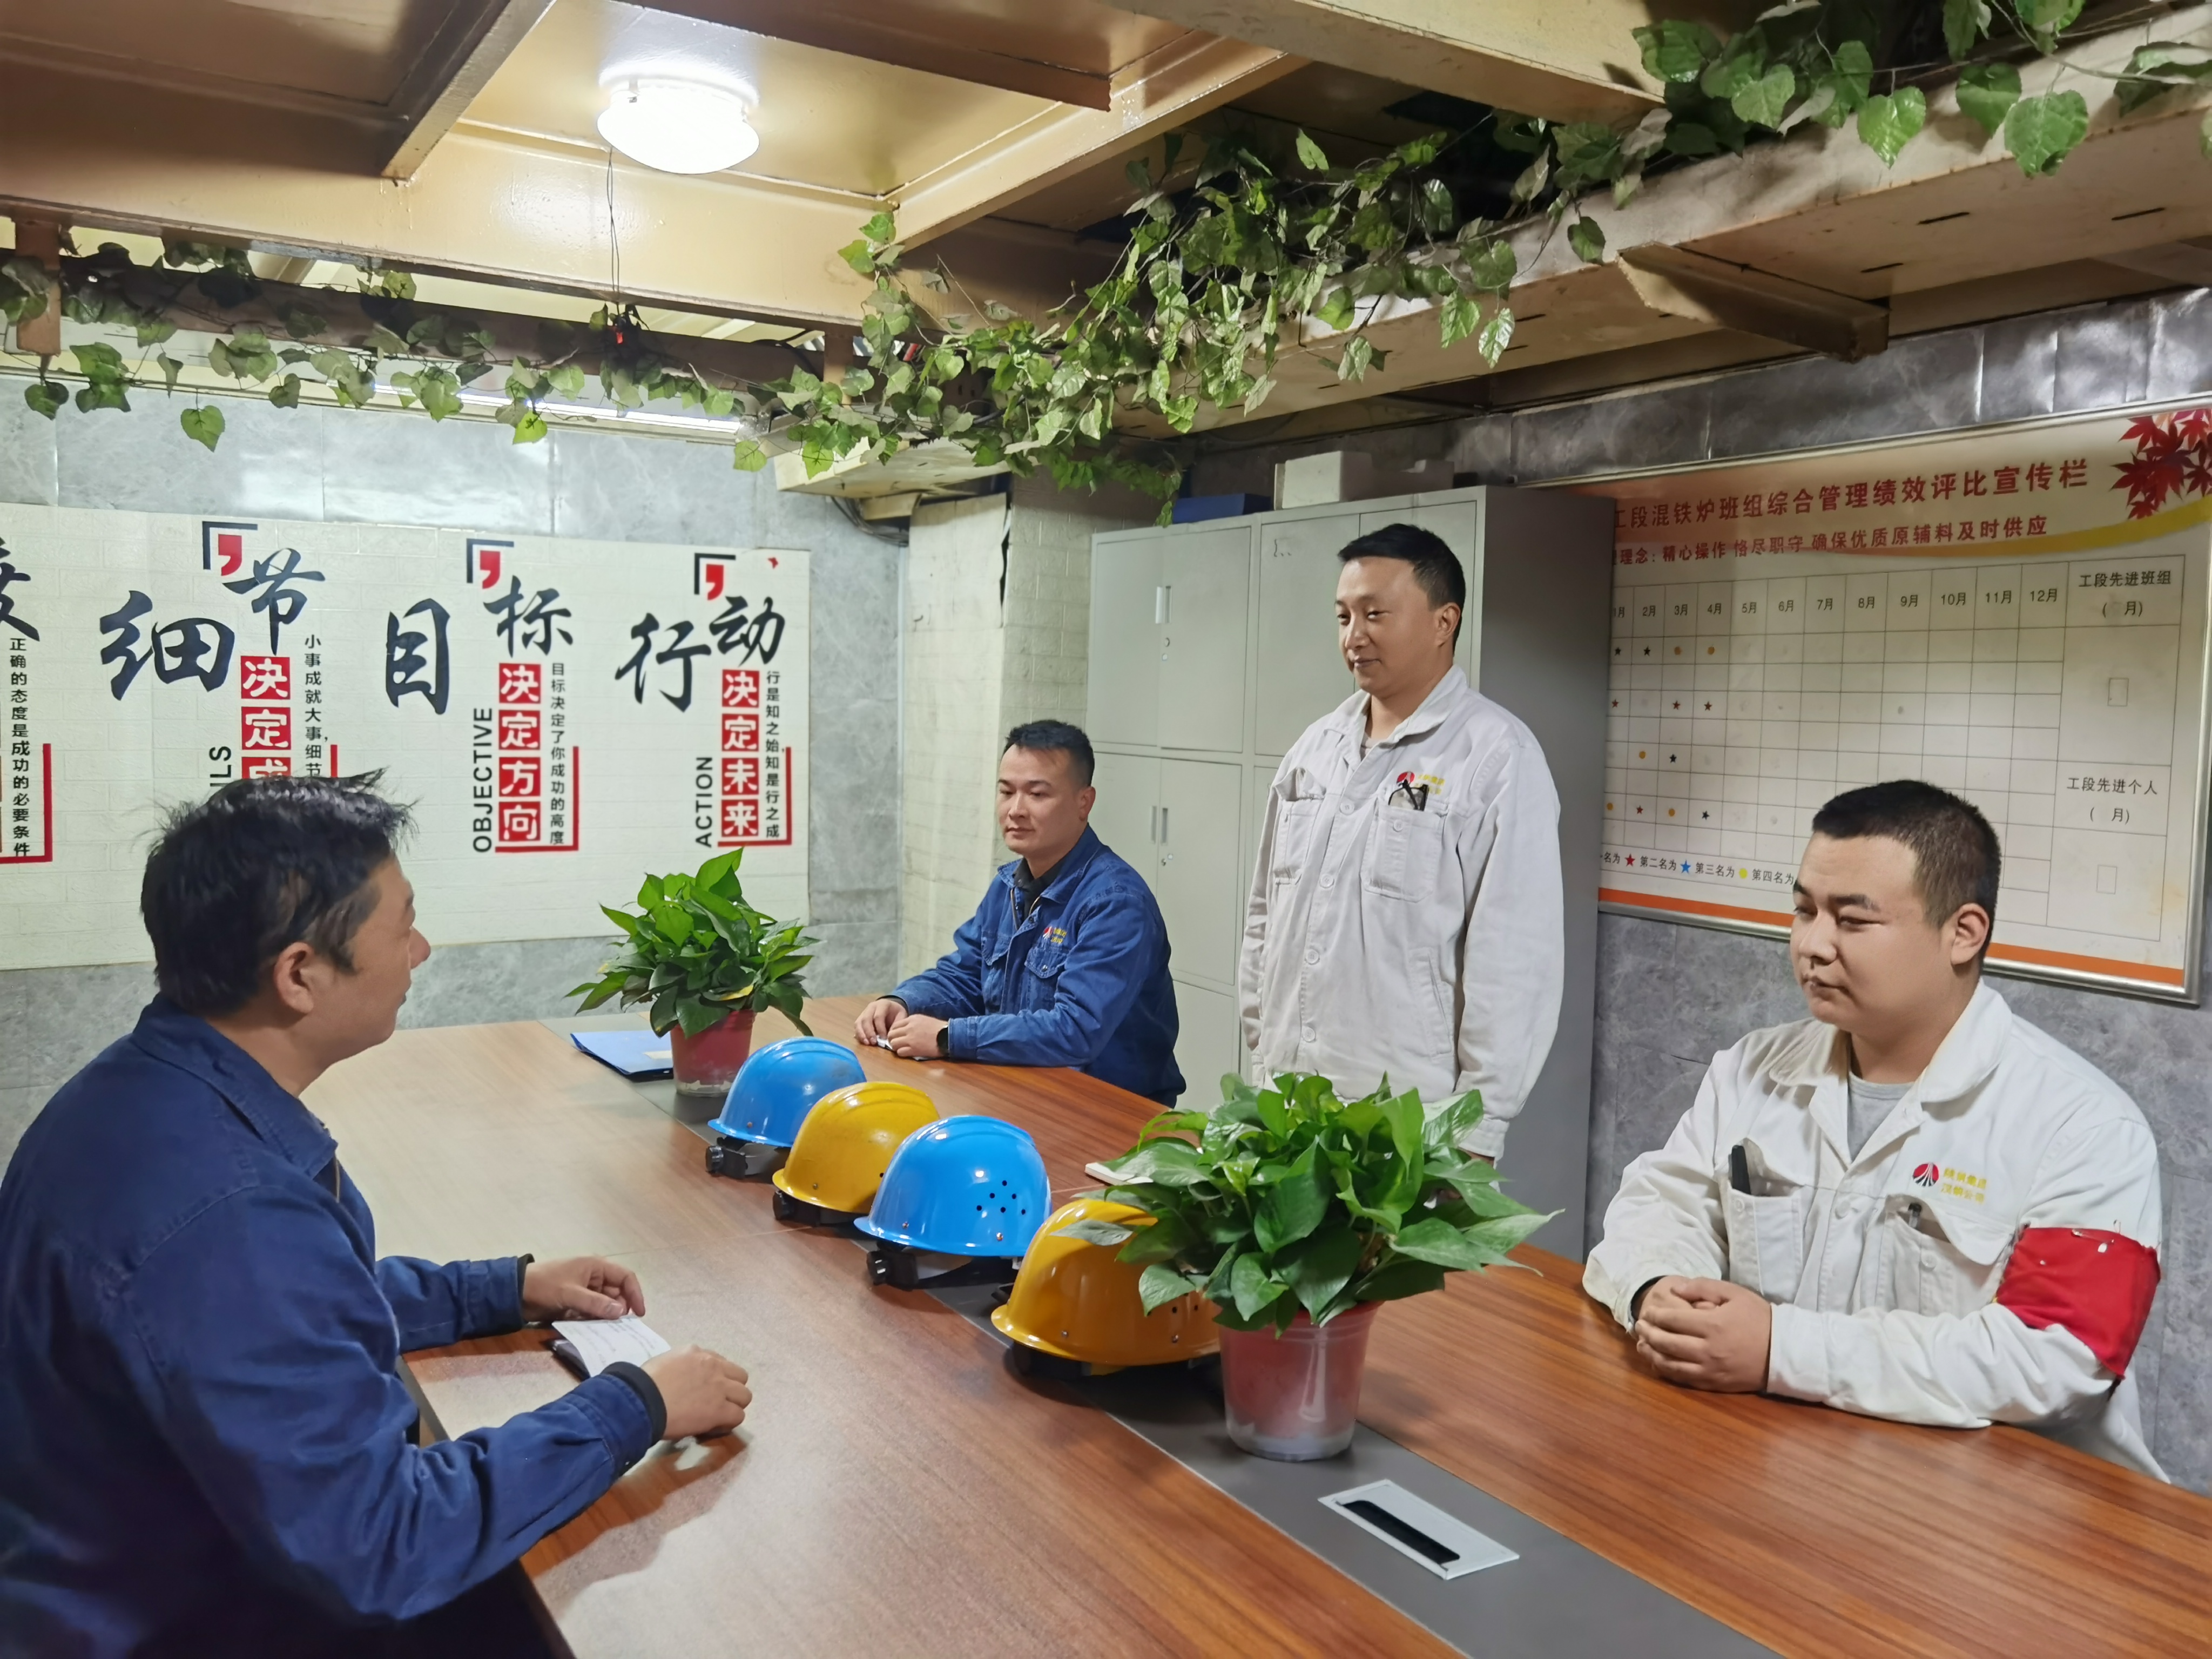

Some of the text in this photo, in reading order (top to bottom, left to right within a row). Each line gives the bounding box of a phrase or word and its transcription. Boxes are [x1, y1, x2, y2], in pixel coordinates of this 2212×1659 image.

[1812, 516, 2047, 550] 确保优质原辅料及时供应
[2079, 570, 2171, 588] 工段先进班组
[99, 548, 326, 700] 细节
[385, 575, 574, 715] 目标
[614, 596, 786, 712] 行动
[1642, 605, 1656, 617] 2月
[1674, 604, 1688, 616] 3月
[1707, 602, 1722, 615] 4月
[1742, 602, 1757, 614] 5月
[1778, 599, 1794, 612] 6月
[1817, 598, 1833, 611] 7月
[1858, 596, 1875, 609] 8月
[1900, 594, 1918, 607] 9月
[1940, 592, 1966, 606] 10月
[1985, 590, 2012, 604] 11月
[2030, 588, 2058, 603] 12月
[9, 638, 30, 857] 正确的态度是成功的必要条件
[473, 707, 493, 853] OBJECTIVE
[501, 665, 539, 840] 决定方向
[550, 663, 565, 845] 目标决定了你成功的高度
[695, 757, 713, 848] ACTION
[723, 671, 758, 835] 决定未来
[2067, 776, 2158, 795] 工段先进个人
[1600, 851, 1794, 885] 名为 第二名为 第三名为 第四名为
